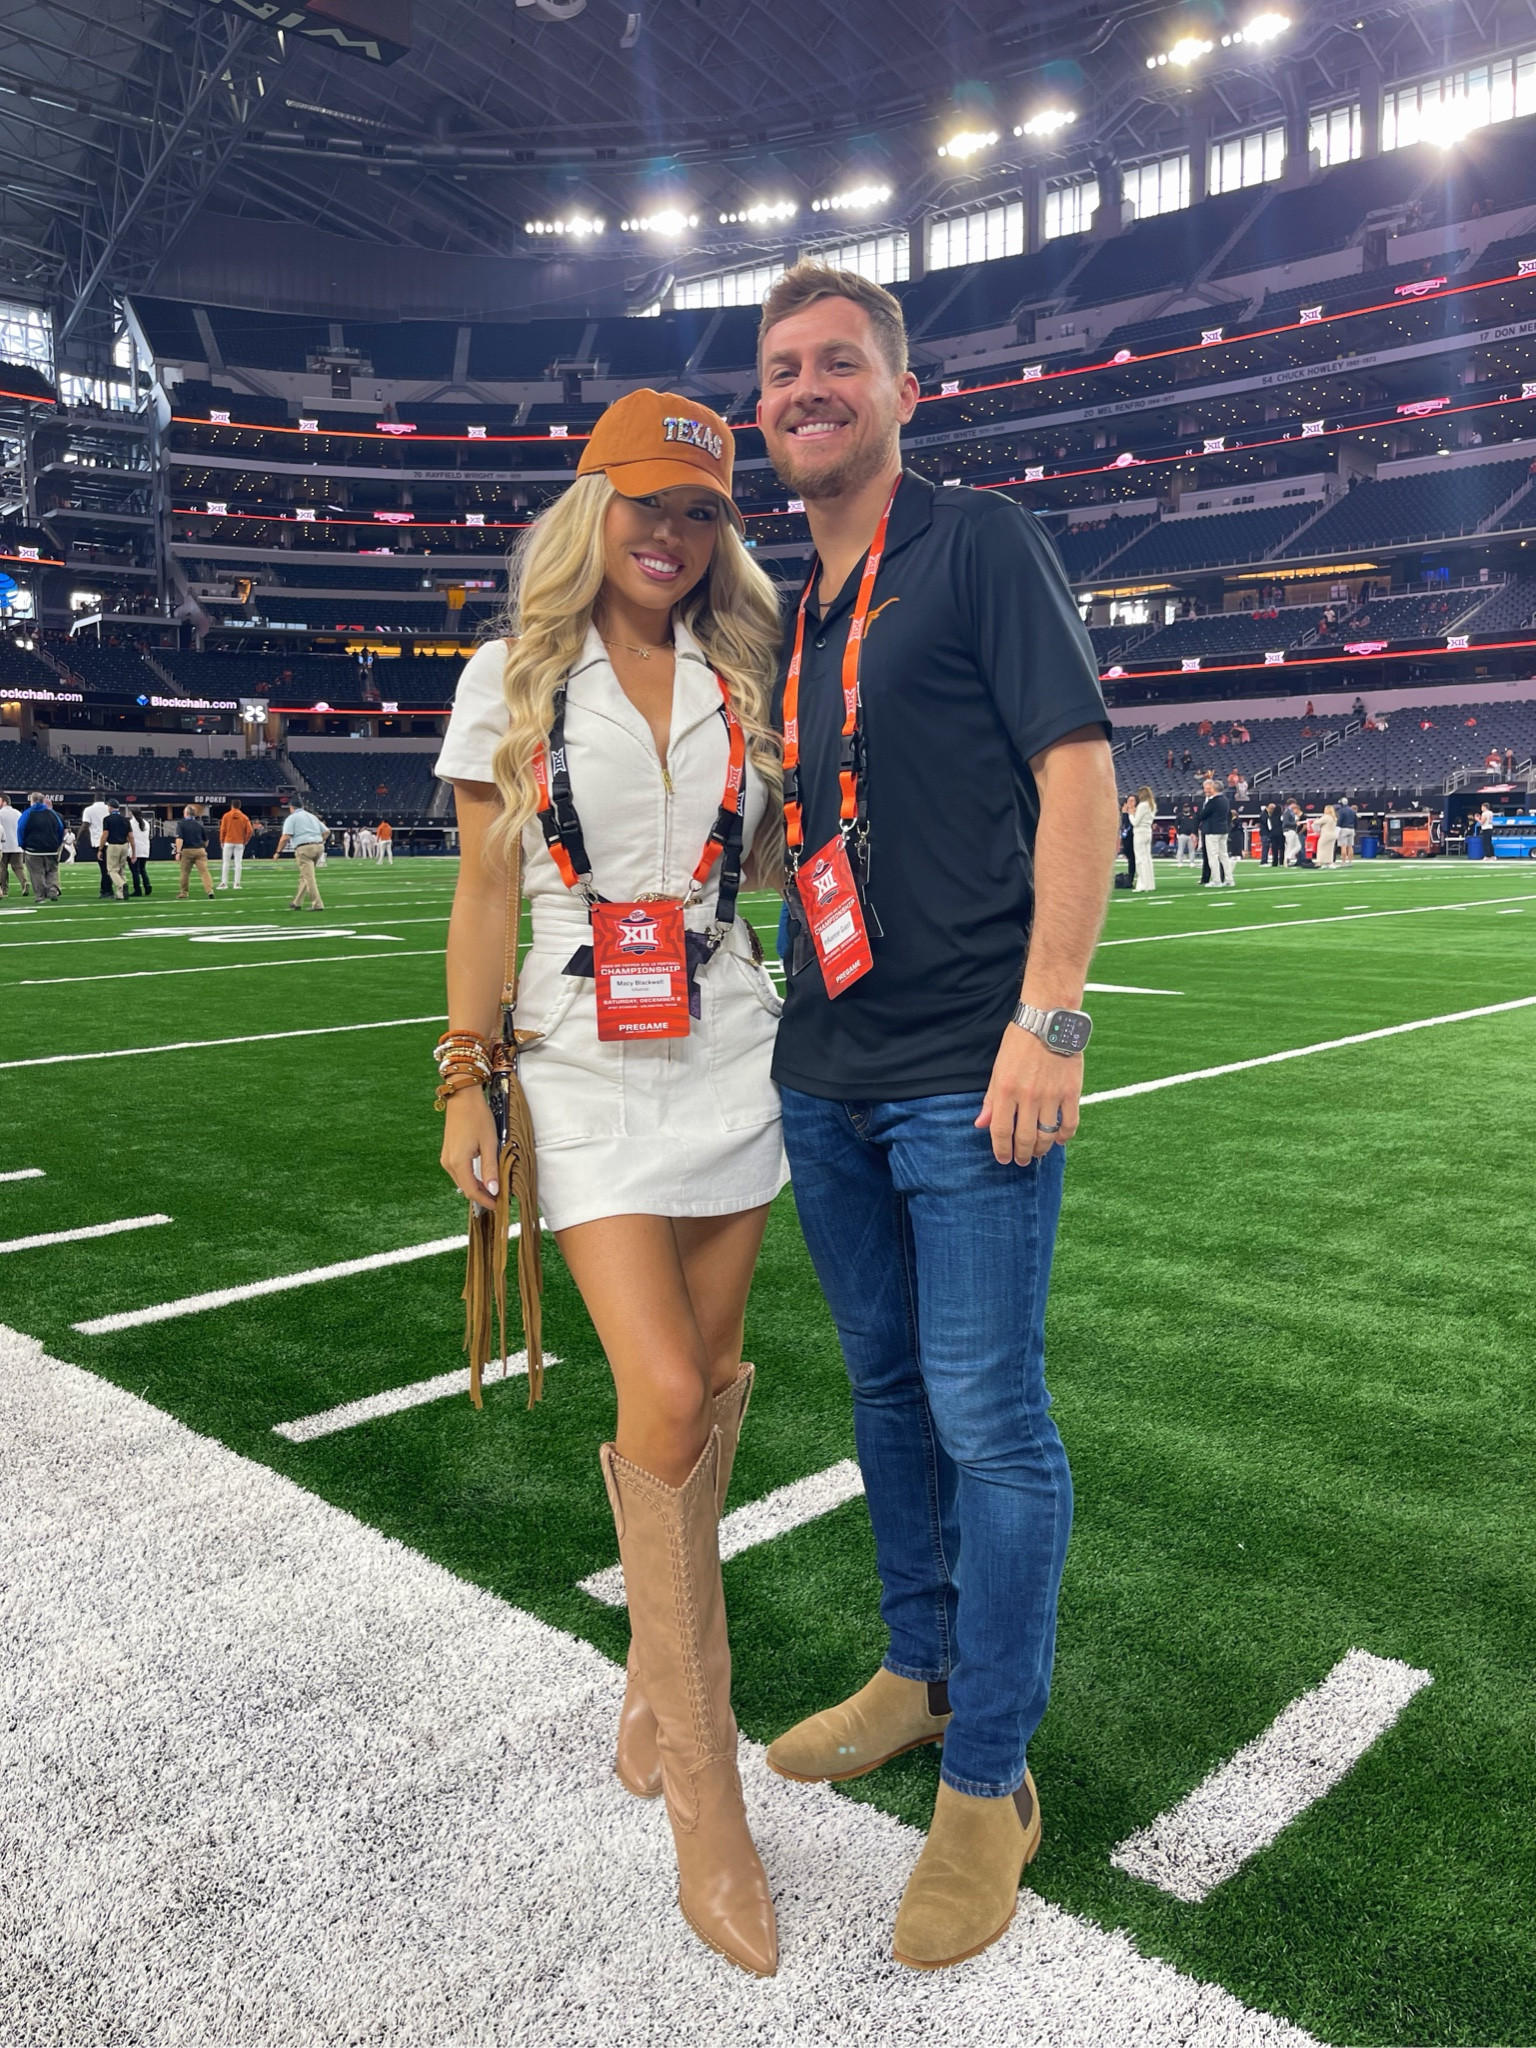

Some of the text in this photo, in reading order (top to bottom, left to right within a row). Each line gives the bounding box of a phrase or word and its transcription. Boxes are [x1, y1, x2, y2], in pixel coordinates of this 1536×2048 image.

[1480, 322, 1536, 341] 17 DON ME
[1261, 376, 1273, 385] 54
[1276, 370, 1305, 382] CHUCK
[1307, 362, 1344, 377] HOWLEY
[1114, 400, 1146, 412] RENFRO
[663, 416, 723, 460] TEXAS
[425, 471, 462, 479] RAYFIELD
[151, 696, 238, 710] Blockchain.com
[243, 705, 266, 723] 25
[812, 867, 838, 899] XII
[618, 923, 660, 946] XII
[600, 965, 681, 976] CHAMPIONSHIP
[835, 959, 862, 984] PREGAME
[618, 1022, 669, 1031] PREGAME
